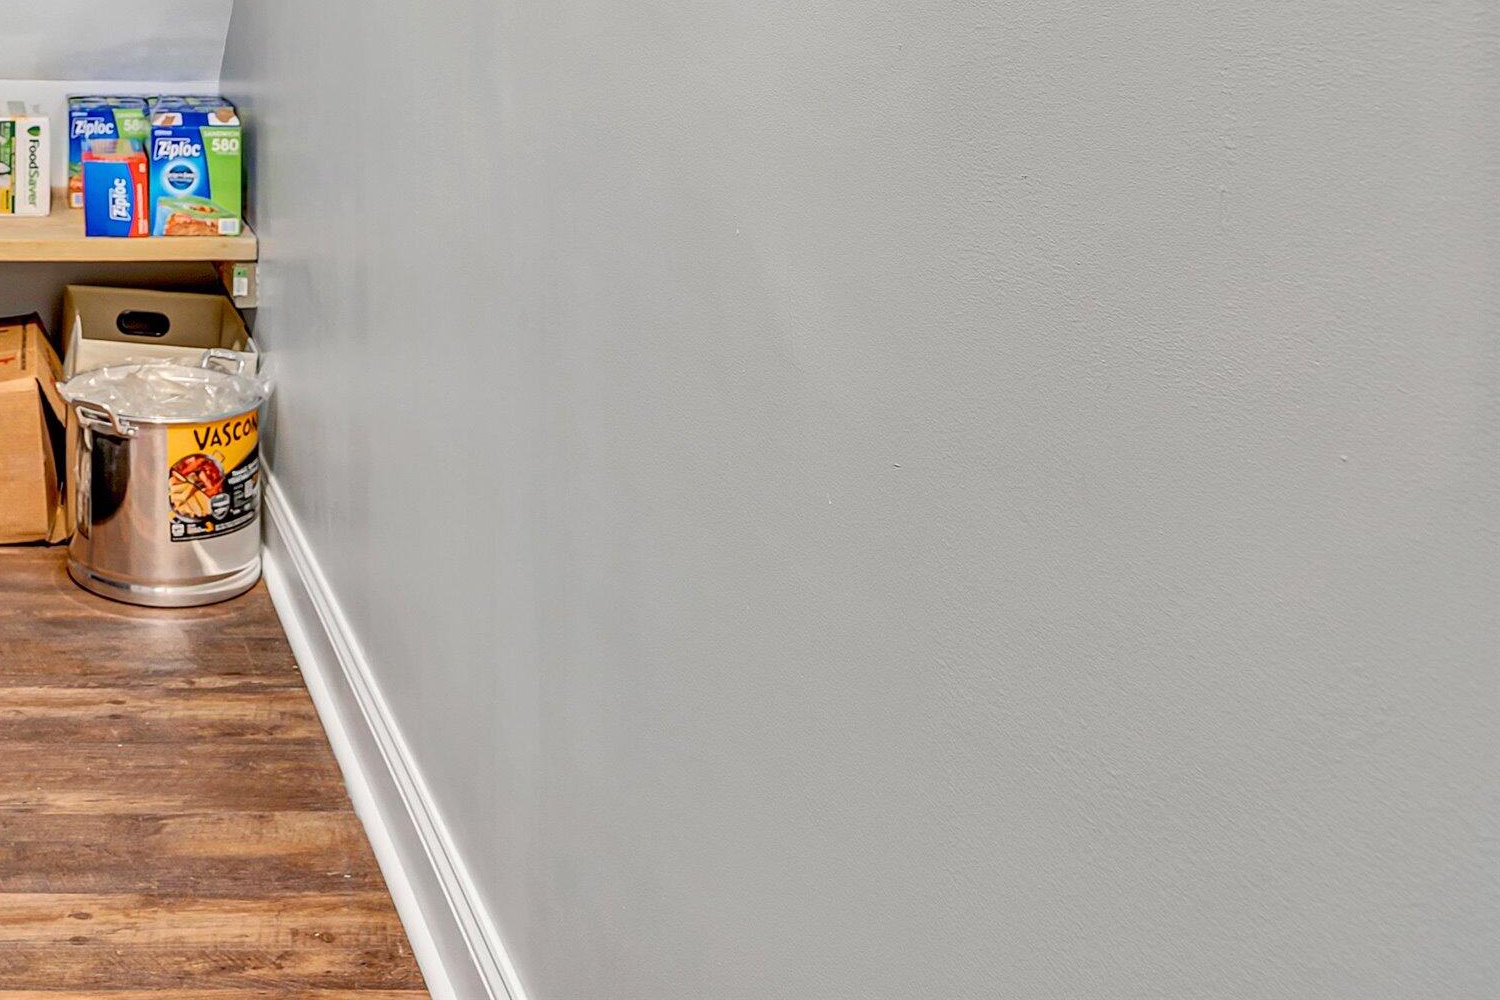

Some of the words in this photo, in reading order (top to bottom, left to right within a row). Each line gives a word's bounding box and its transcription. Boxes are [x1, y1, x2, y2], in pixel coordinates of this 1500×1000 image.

[75, 119, 115, 138] Ziploc
[158, 140, 201, 160] Ziploc
[211, 138, 239, 152] 580
[28, 139, 40, 207] FoodSaver
[113, 178, 130, 217] Ziploc
